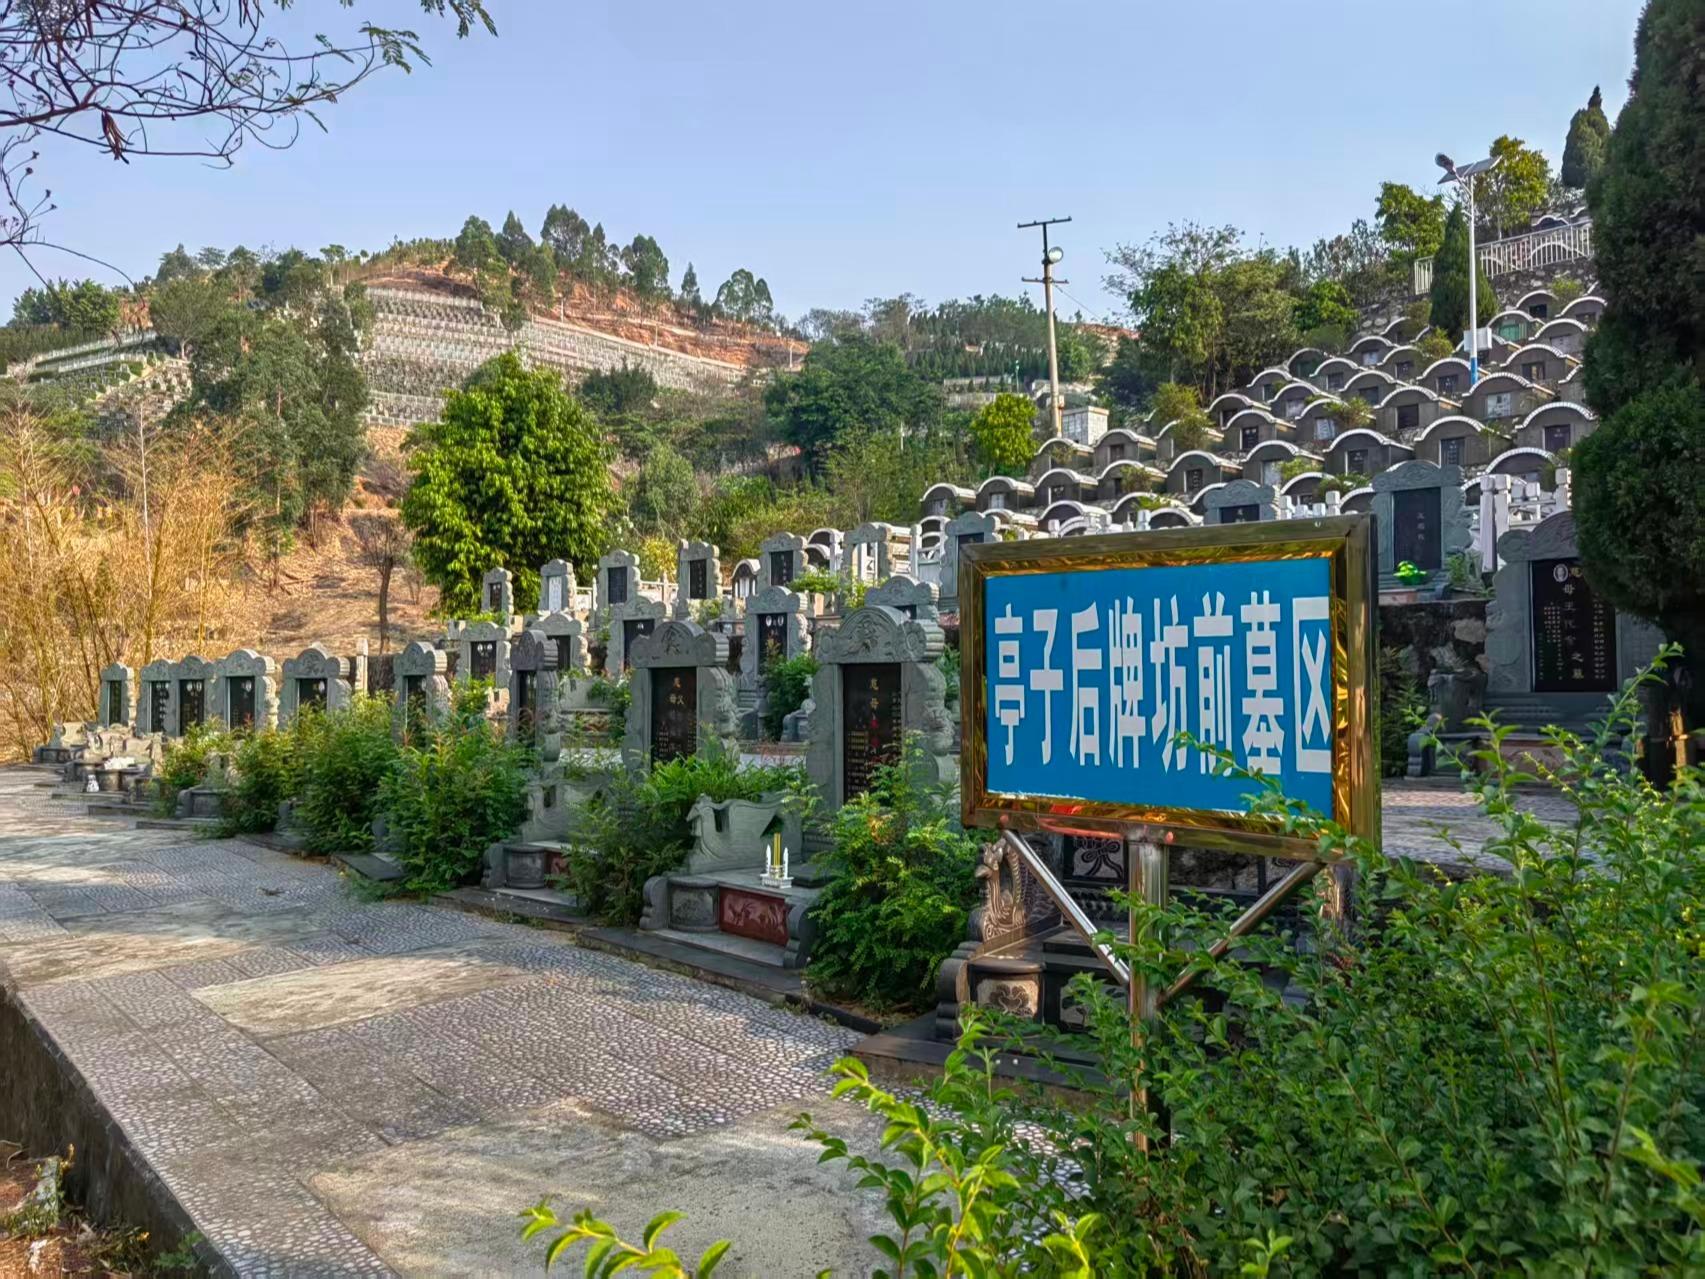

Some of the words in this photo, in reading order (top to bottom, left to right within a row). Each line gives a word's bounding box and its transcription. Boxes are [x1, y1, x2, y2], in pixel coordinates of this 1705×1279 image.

[994, 590, 1331, 776] 亭子后牌坊前墓区
